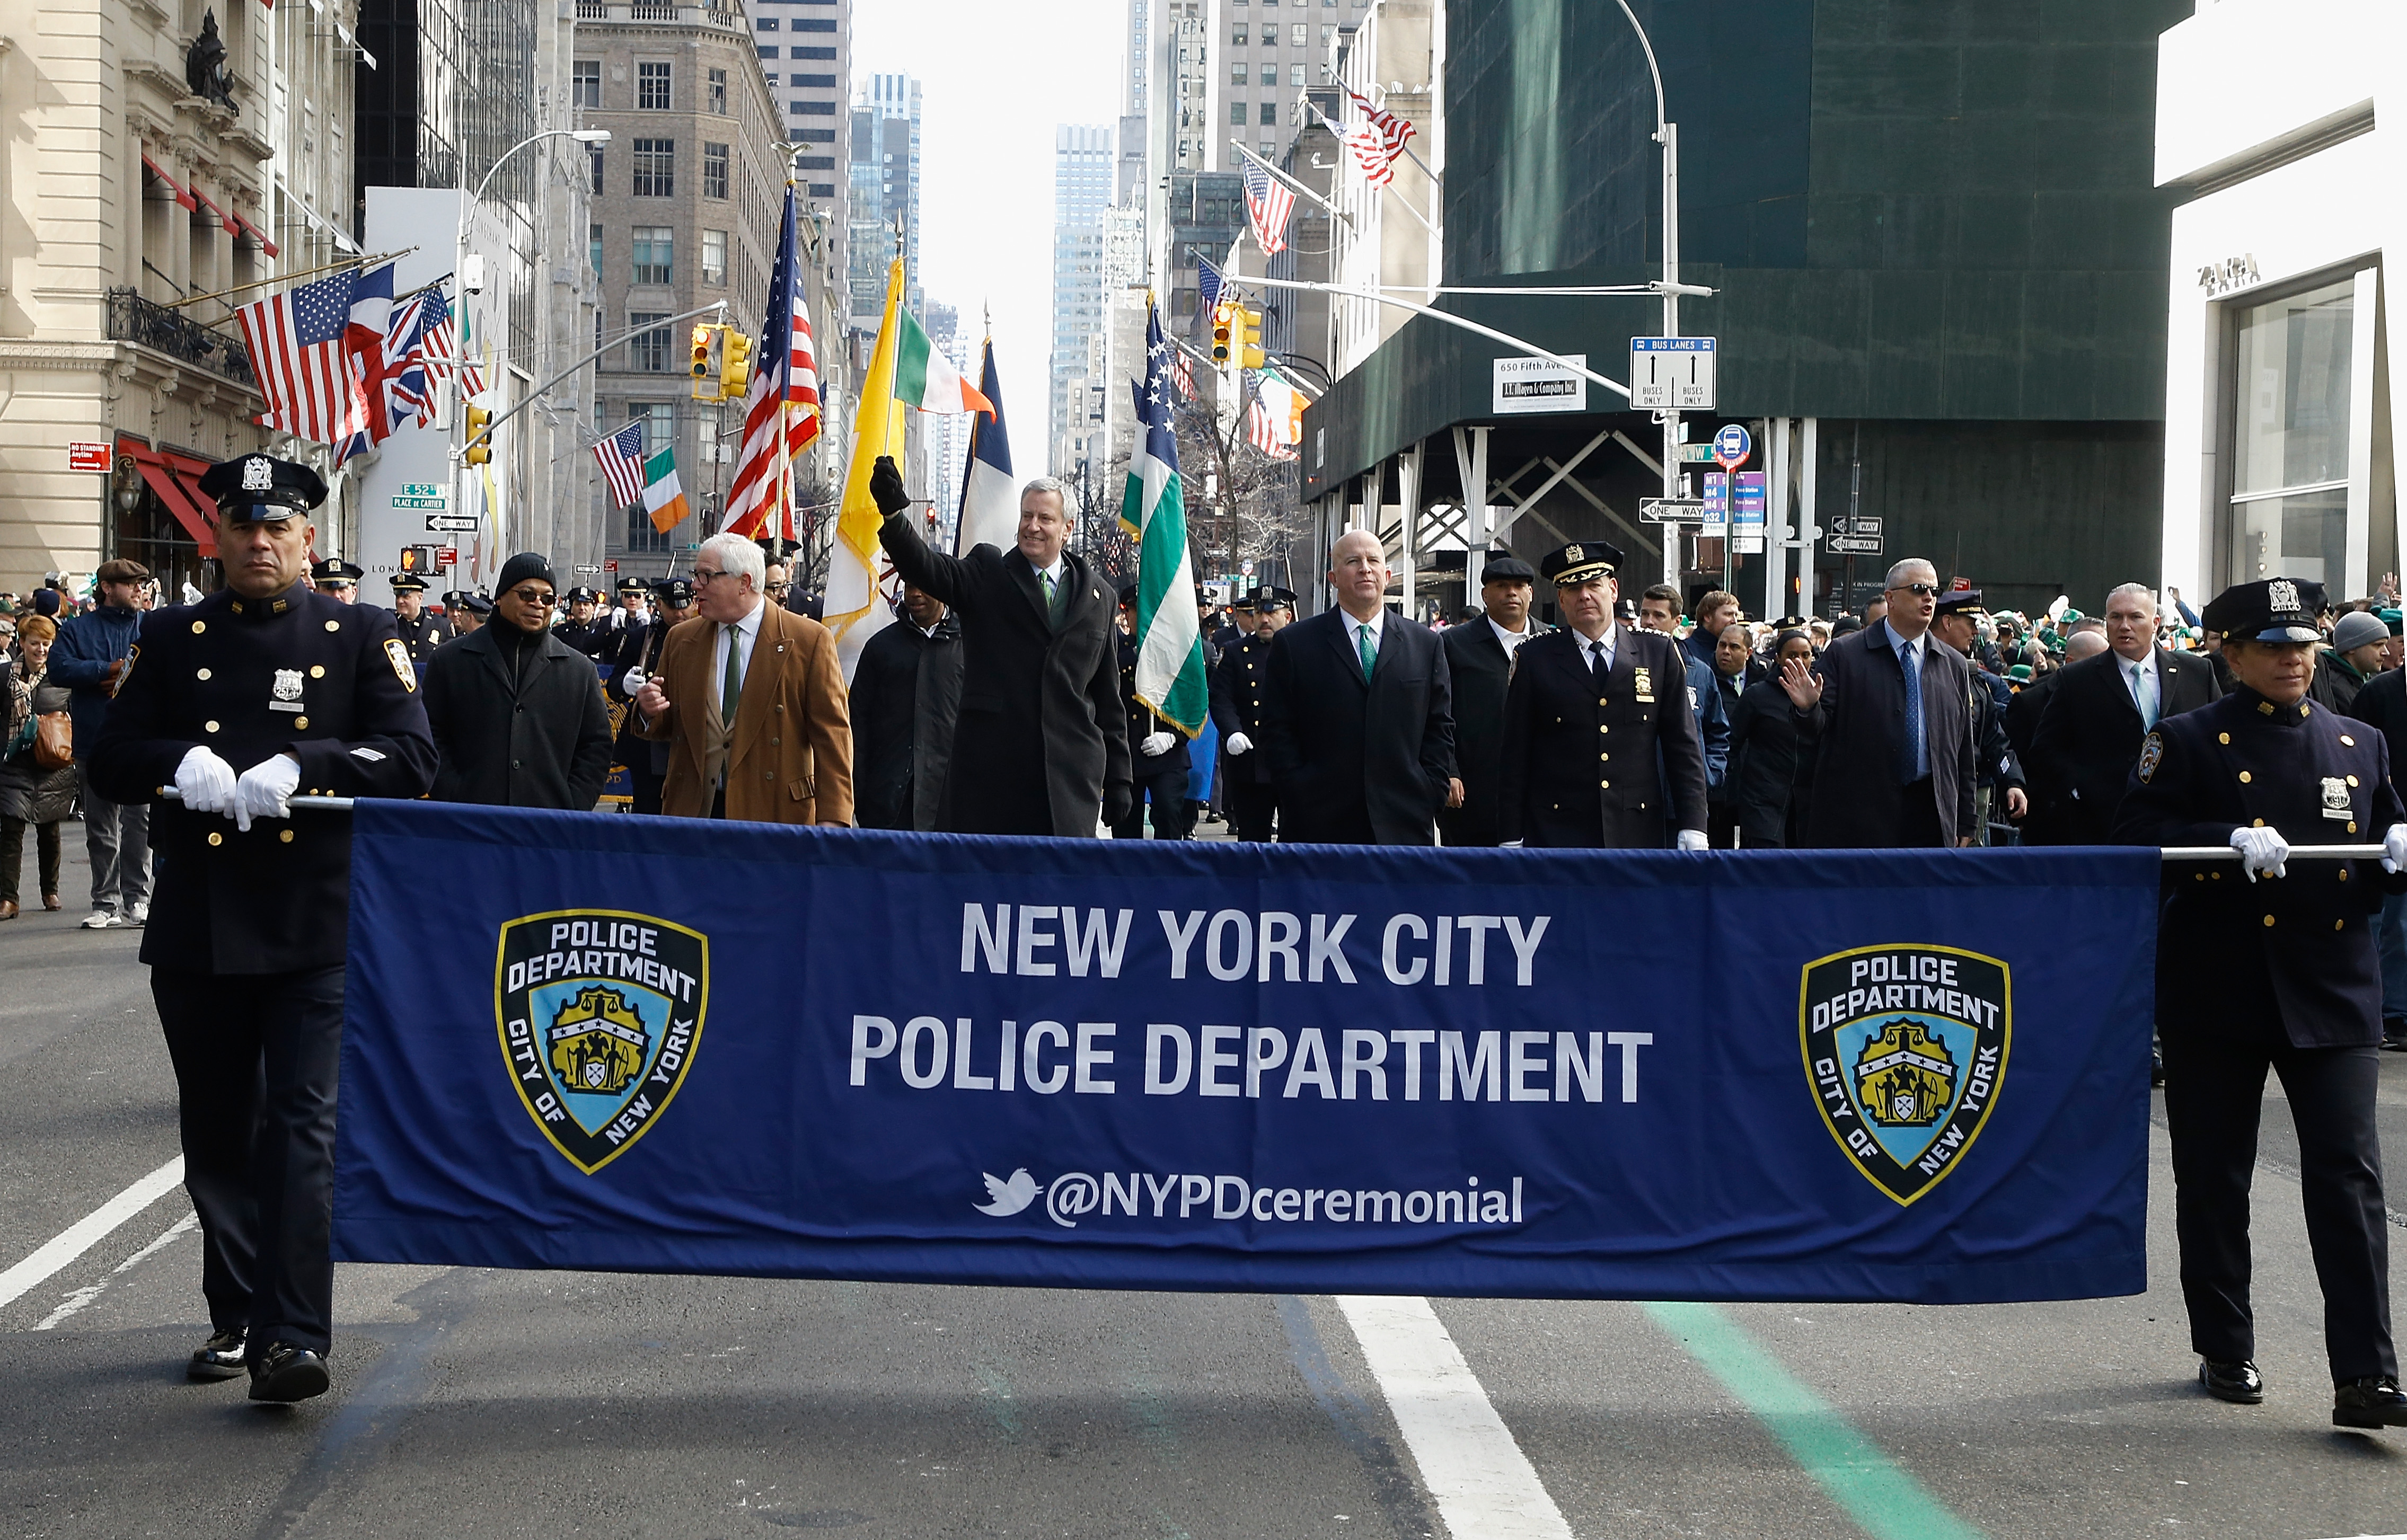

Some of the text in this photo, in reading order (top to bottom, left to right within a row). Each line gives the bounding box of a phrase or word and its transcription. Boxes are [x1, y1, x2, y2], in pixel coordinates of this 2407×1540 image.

[2197, 253, 2258, 287] ZARA
[1652, 340, 1695, 349] BUS LANES
[1501, 363, 1518, 371] 650
[1521, 361, 1541, 371] Fifth
[1515, 383, 1533, 396] Magen
[1534, 383, 1538, 394] &
[1539, 382, 1564, 396] Company
[1565, 380, 1575, 393] Inc.
[1642, 386, 1663, 395] BUSES
[1682, 386, 1703, 395] BUSES
[1696, 446, 1705, 459] W
[1723, 454, 1747, 465] STANDING
[1706, 474, 1717, 485] M1
[403, 485, 410, 494] E
[415, 485, 429, 495] 52
[1705, 487, 1717, 497] M4
[394, 498, 411, 507] PLACE
[420, 500, 443, 508] CARTIER
[1705, 499, 1717, 510] M4
[1650, 506, 1703, 516] ONE WAY
[551, 921, 658, 956] POLICE
[960, 902, 1551, 986] NEW YORK CITY
[508, 950, 696, 1003] DEPARTMENT
[1851, 955, 1958, 987] POLICE
[1813, 984, 1999, 1033] DEPARTMENT
[849, 1014, 1654, 1103] POLICE DEPARTMENT
[508, 1019, 693, 1145] CITY OF NEW YORK
[1815, 1046, 1998, 1176] CITY OF NEW YORK
[1046, 1172, 1523, 1228] @NYPDceremonial
